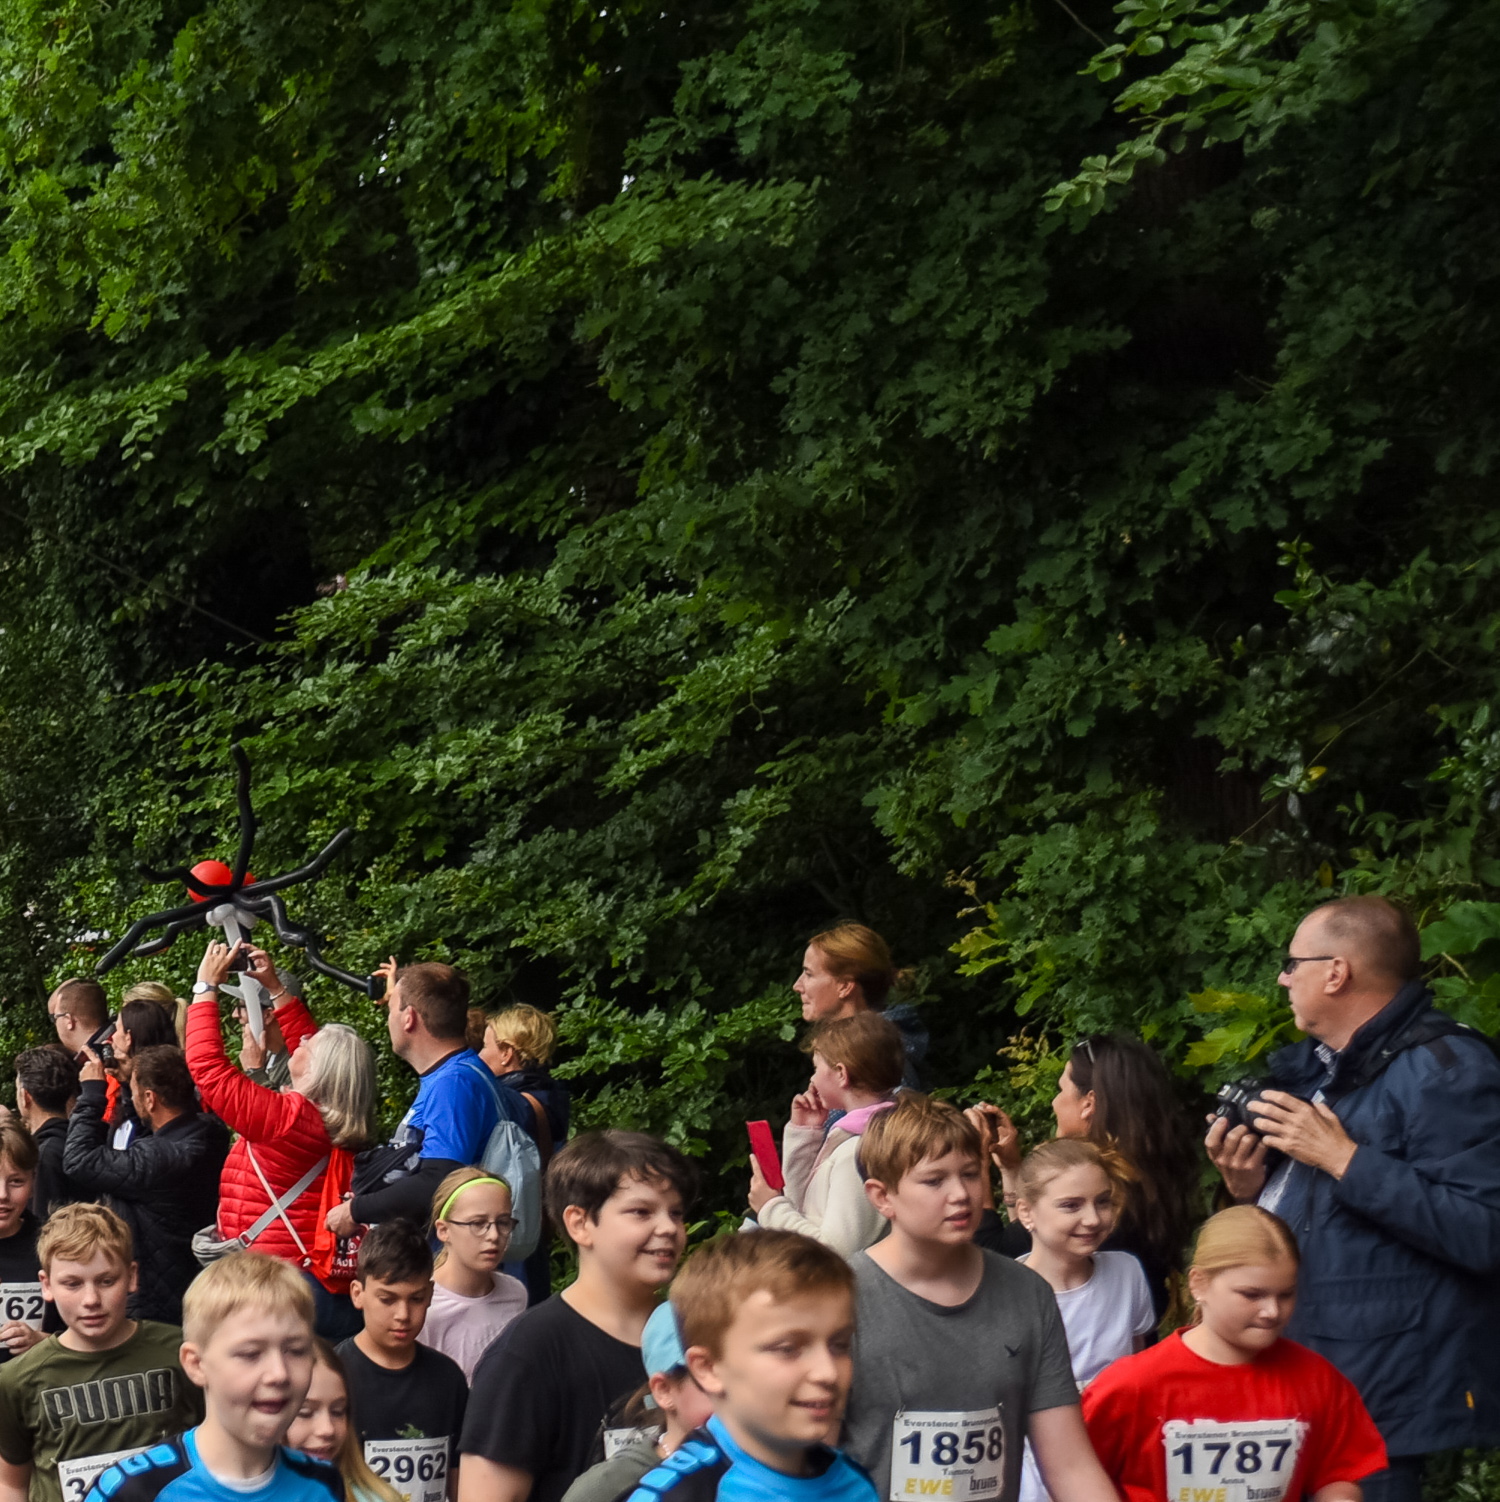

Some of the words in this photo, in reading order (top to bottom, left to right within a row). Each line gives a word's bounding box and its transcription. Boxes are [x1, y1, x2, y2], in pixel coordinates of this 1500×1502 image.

[41, 1368, 174, 1431] PUMA
[904, 1419, 959, 1428] Everstener
[900, 1426, 1002, 1466] 1858
[1172, 1439, 1292, 1475] 1787
[368, 1451, 447, 1483] 2962
[904, 1477, 954, 1496] EWE
